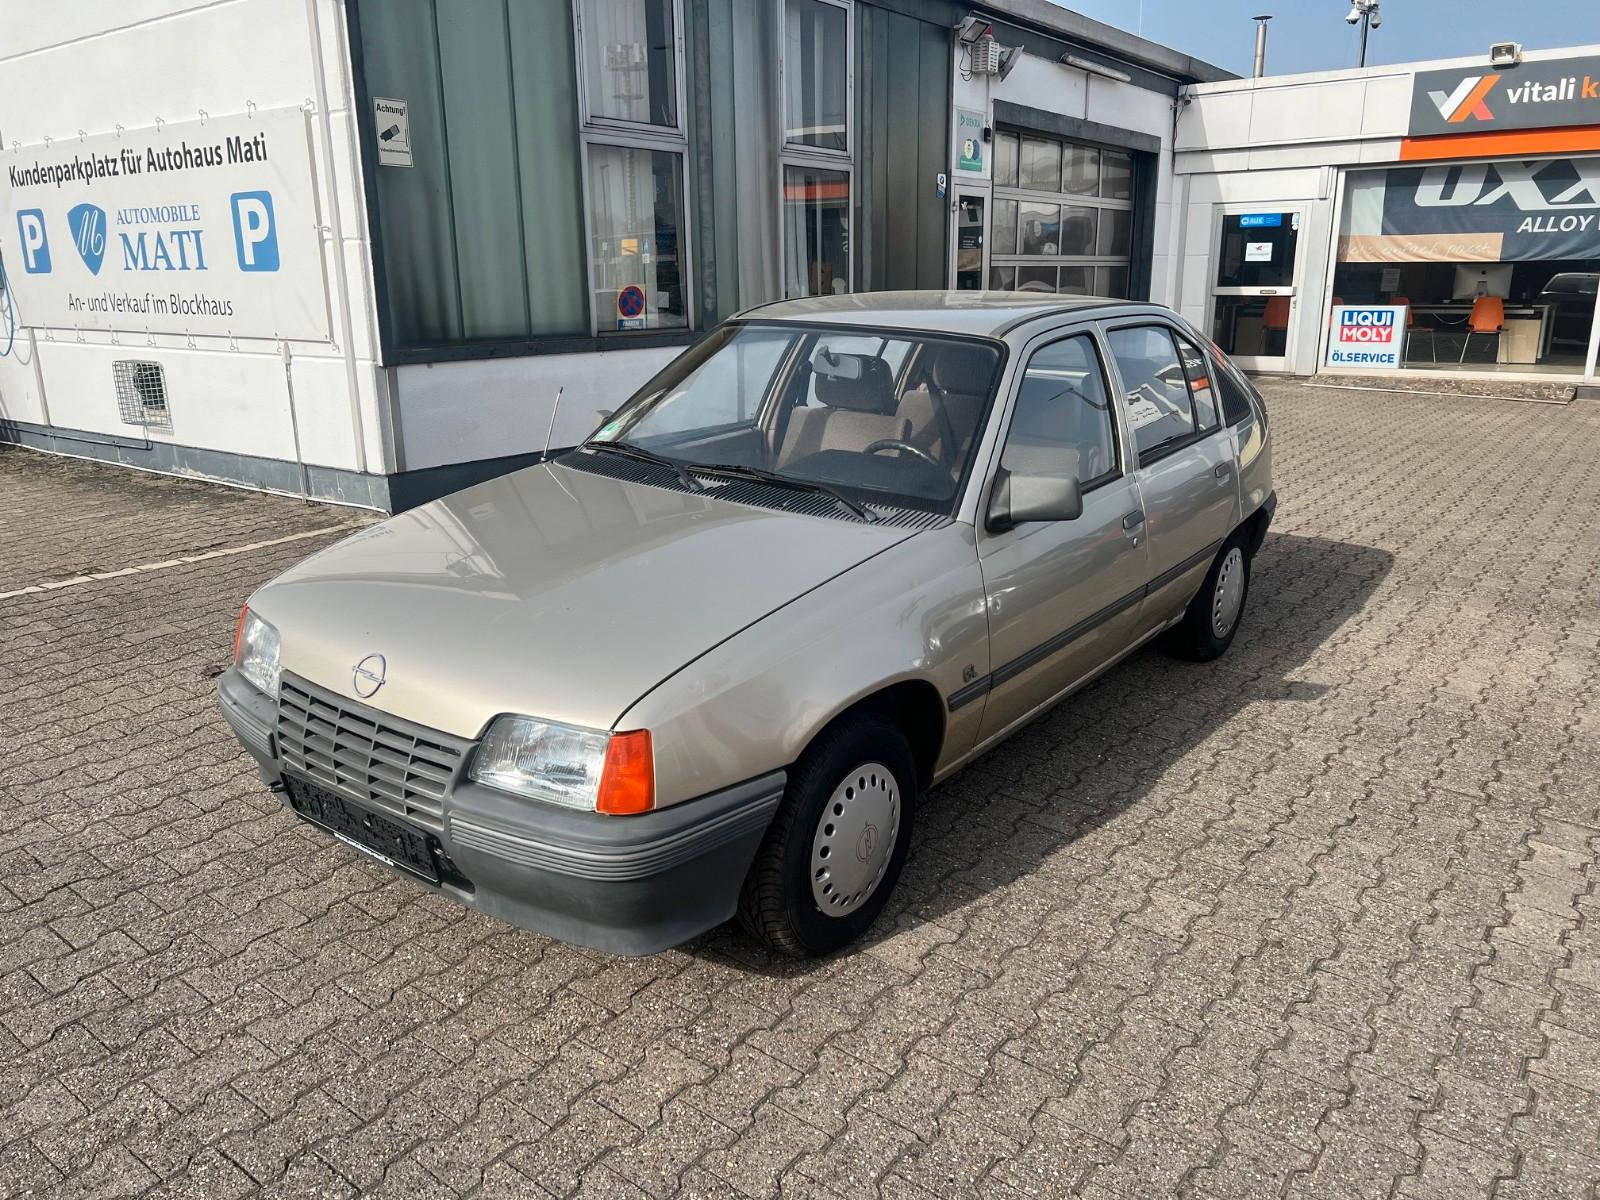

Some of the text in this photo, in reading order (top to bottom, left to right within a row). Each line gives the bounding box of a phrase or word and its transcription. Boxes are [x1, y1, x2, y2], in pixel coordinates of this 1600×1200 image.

[1506, 75, 1600, 104] vitali k
[376, 103, 406, 116] Achtung!
[9, 131, 267, 188] Kundenparkplatz für Autohaus Mati
[116, 204, 201, 225] AUTOMOBILE
[1516, 215, 1595, 233] ALLOY
[118, 229, 208, 271] MATI
[68, 292, 233, 316] An- und Verkauf im Blockhaus
[1343, 311, 1392, 326] LIQUI
[1341, 327, 1392, 342] MOLY
[1332, 349, 1395, 363] ÖLSERVICE
